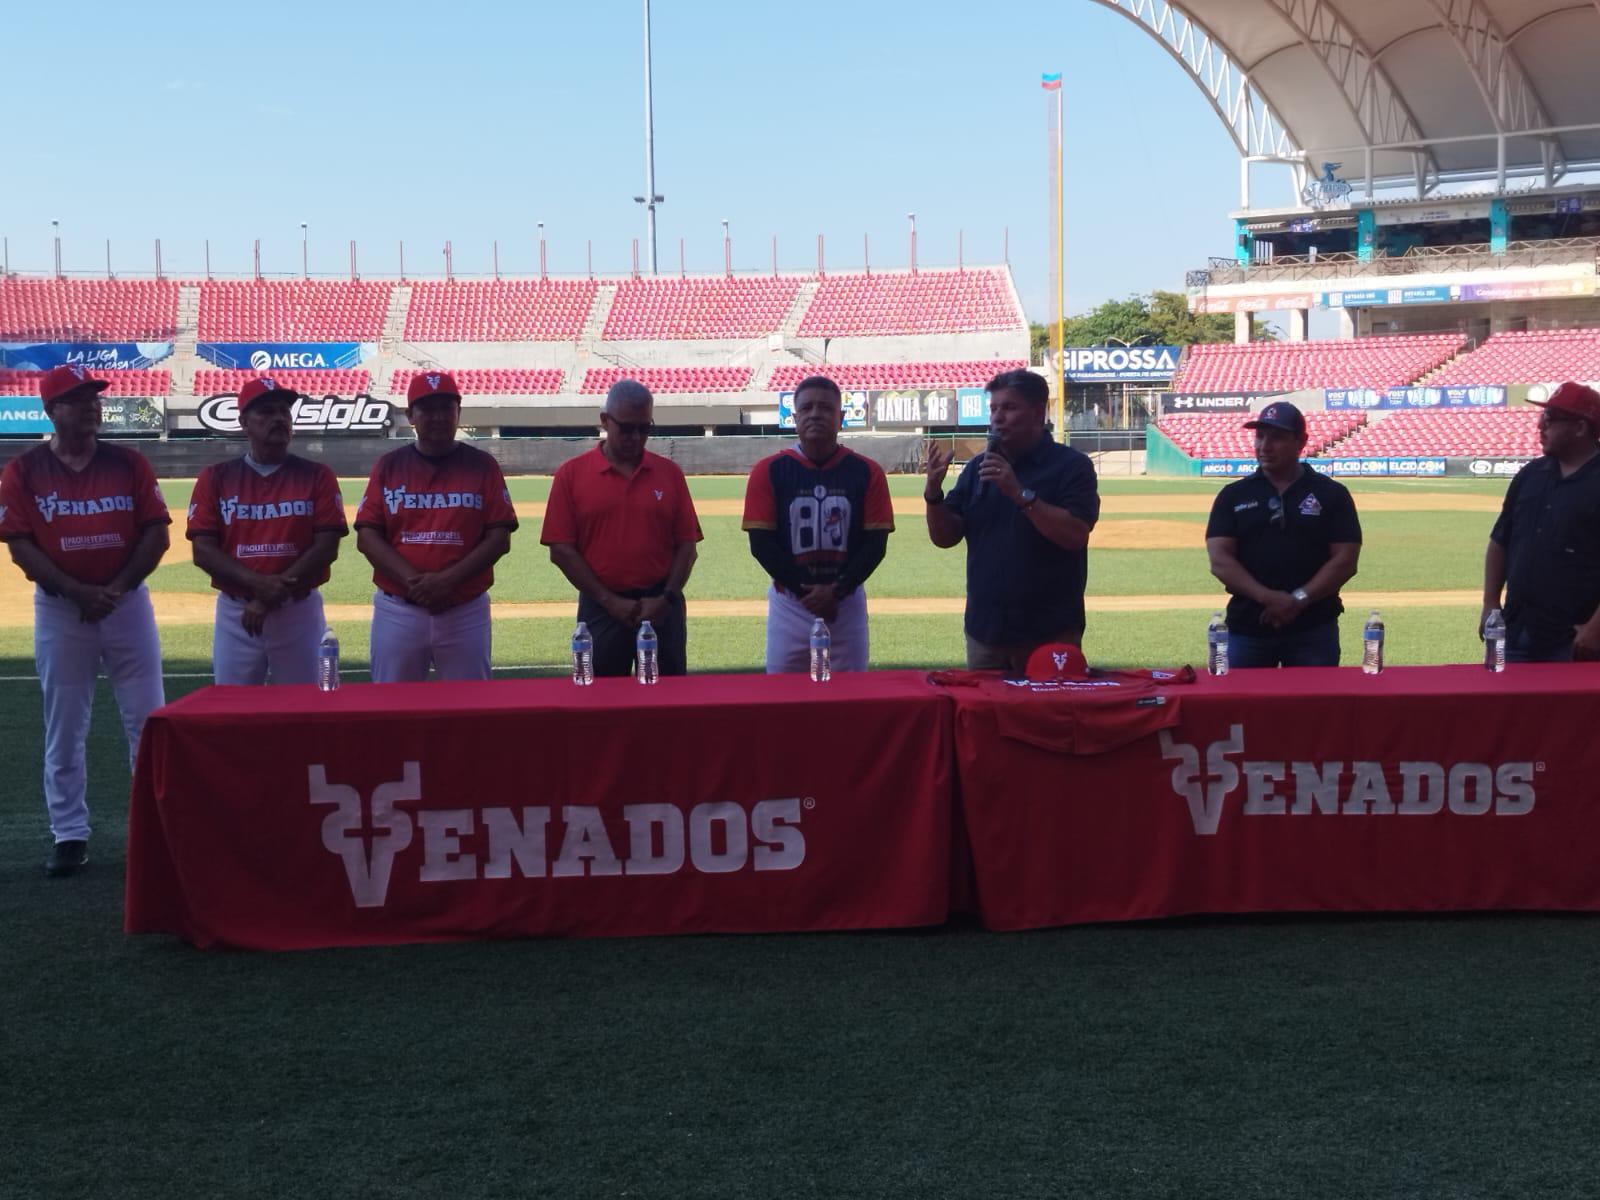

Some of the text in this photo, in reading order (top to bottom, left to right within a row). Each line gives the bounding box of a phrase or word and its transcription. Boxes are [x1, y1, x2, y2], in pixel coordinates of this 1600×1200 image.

[66, 348, 119, 363] LA LIGA
[273, 352, 326, 368] MEGA
[877, 397, 922, 422] BANDA
[927, 396, 948, 421] MS
[1196, 397, 1245, 407] UNDER
[383, 484, 483, 515] VENADOS
[1158, 723, 1537, 835] VENADOS
[307, 760, 807, 909] VENADOS
